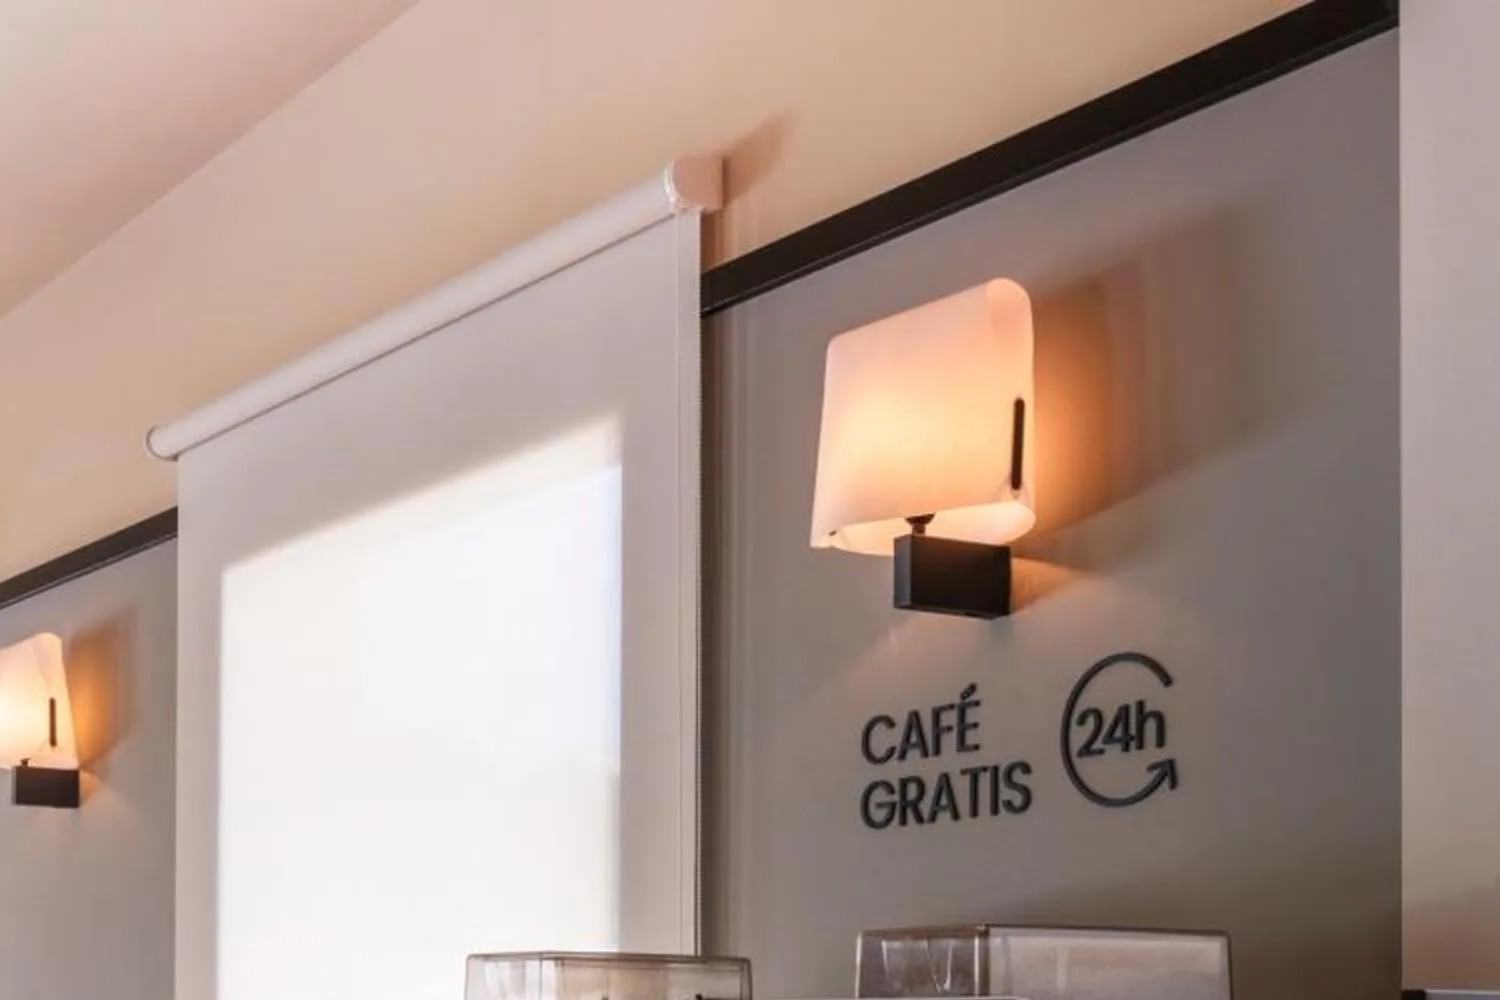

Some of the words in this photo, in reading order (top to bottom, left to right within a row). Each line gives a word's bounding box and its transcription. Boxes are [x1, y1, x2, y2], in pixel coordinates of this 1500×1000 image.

[861, 683, 981, 765] CAFÉ
[1075, 700, 1167, 758] 24h
[860, 760, 1032, 830] GRATIS
